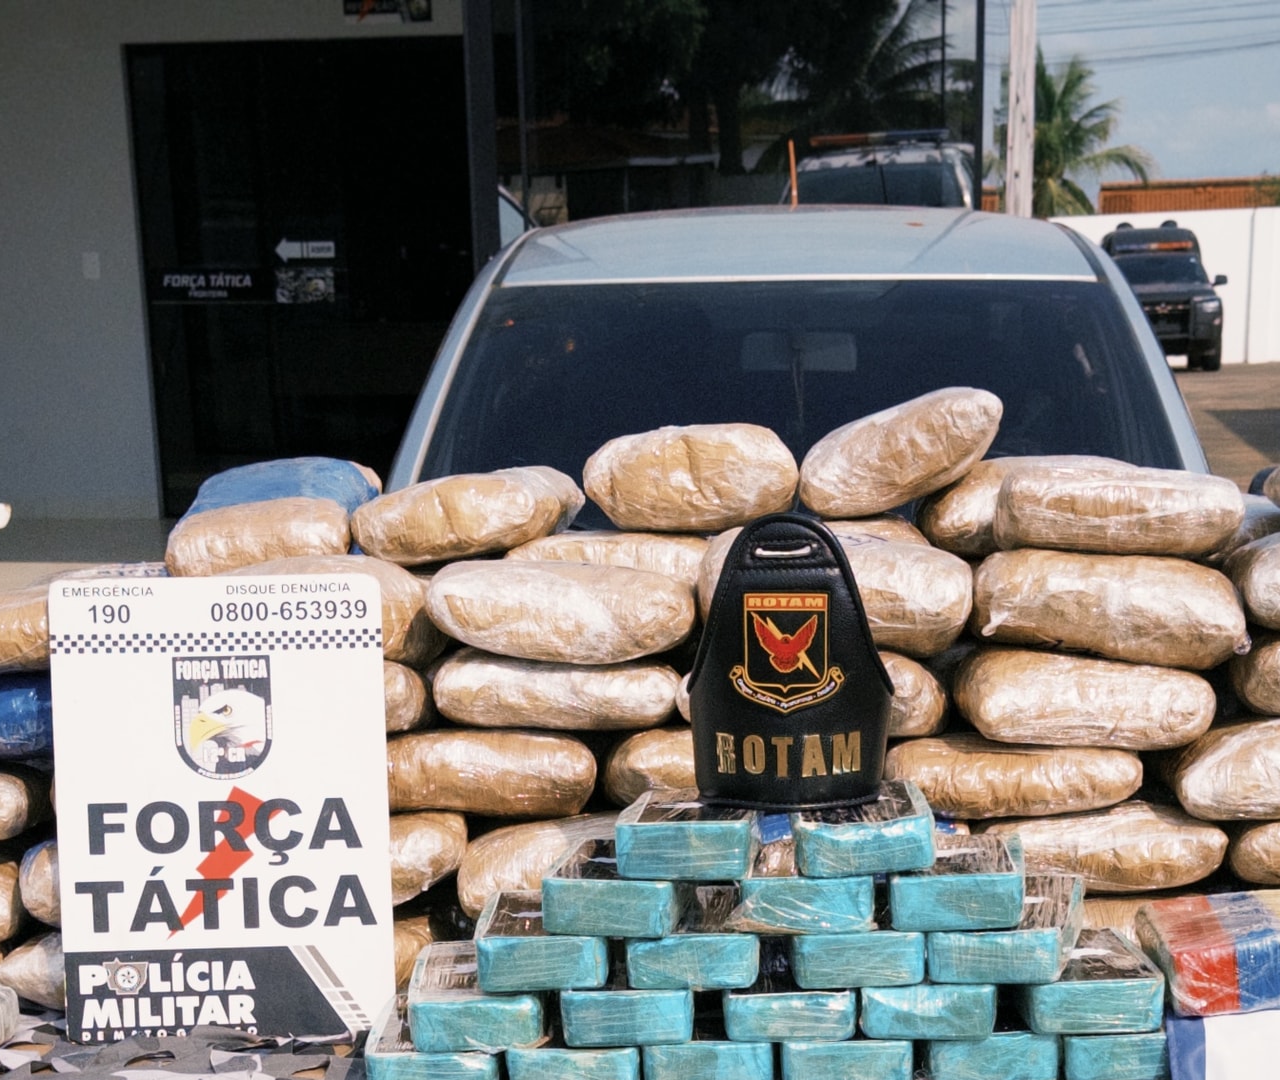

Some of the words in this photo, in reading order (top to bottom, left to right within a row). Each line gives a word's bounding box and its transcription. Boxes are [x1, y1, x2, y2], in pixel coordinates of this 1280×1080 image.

[163, 274, 206, 290] FORÇA
[209, 271, 252, 288] TÁTICA
[62, 586, 154, 598] EMERGÊNCIA
[226, 584, 277, 596] DISQUE
[281, 581, 351, 594] DENÚNCIA
[749, 597, 824, 607] ROTAM
[88, 604, 131, 624] 190
[210, 600, 368, 622] 0800-653939
[175, 660, 220, 683] FORÇA
[221, 657, 268, 679] TÁTICA
[715, 731, 862, 778] ROTAM
[87, 797, 363, 865] FORÇA
[75, 866, 378, 934] TÁTICA
[81, 995, 258, 1029] MILITAR
[82, 1031, 105, 1042] DE
